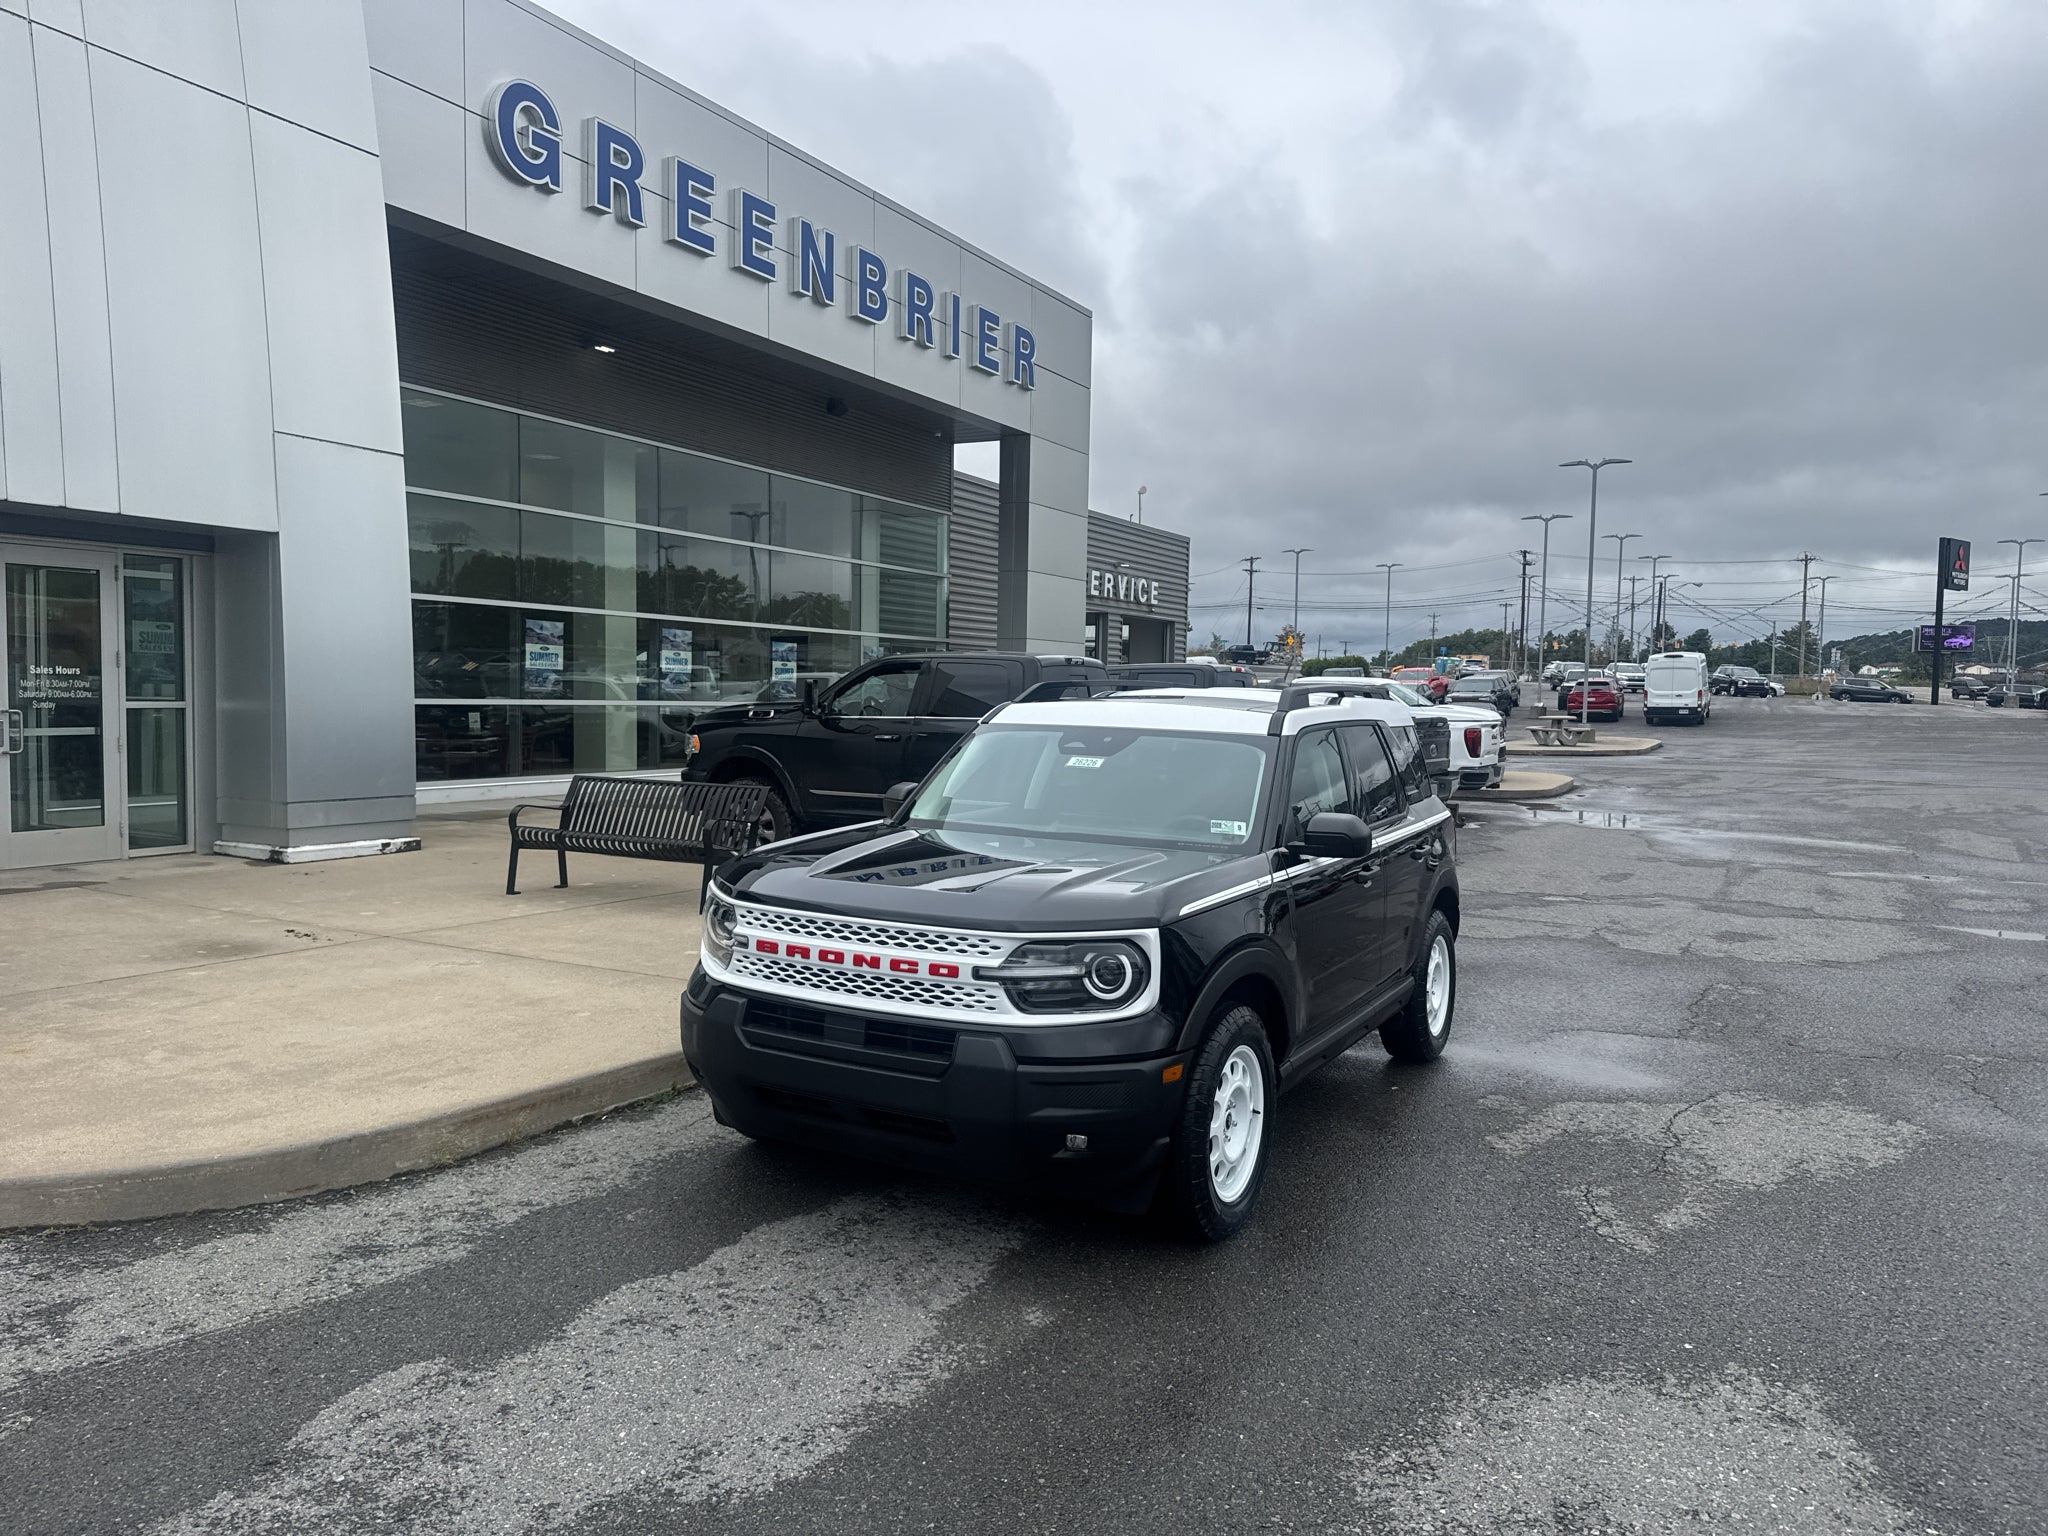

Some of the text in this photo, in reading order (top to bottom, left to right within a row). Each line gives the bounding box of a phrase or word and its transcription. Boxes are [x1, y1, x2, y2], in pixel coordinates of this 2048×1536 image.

[486, 77, 1037, 391] GREENBRIER
[1091, 570, 1159, 604] ERVICE
[529, 651, 560, 662] SUMMER
[29, 665, 81, 675] Sales Hours
[18, 690, 47, 699] Saturday
[32, 700, 56, 710] Sunday
[755, 938, 960, 979] BRONCO
